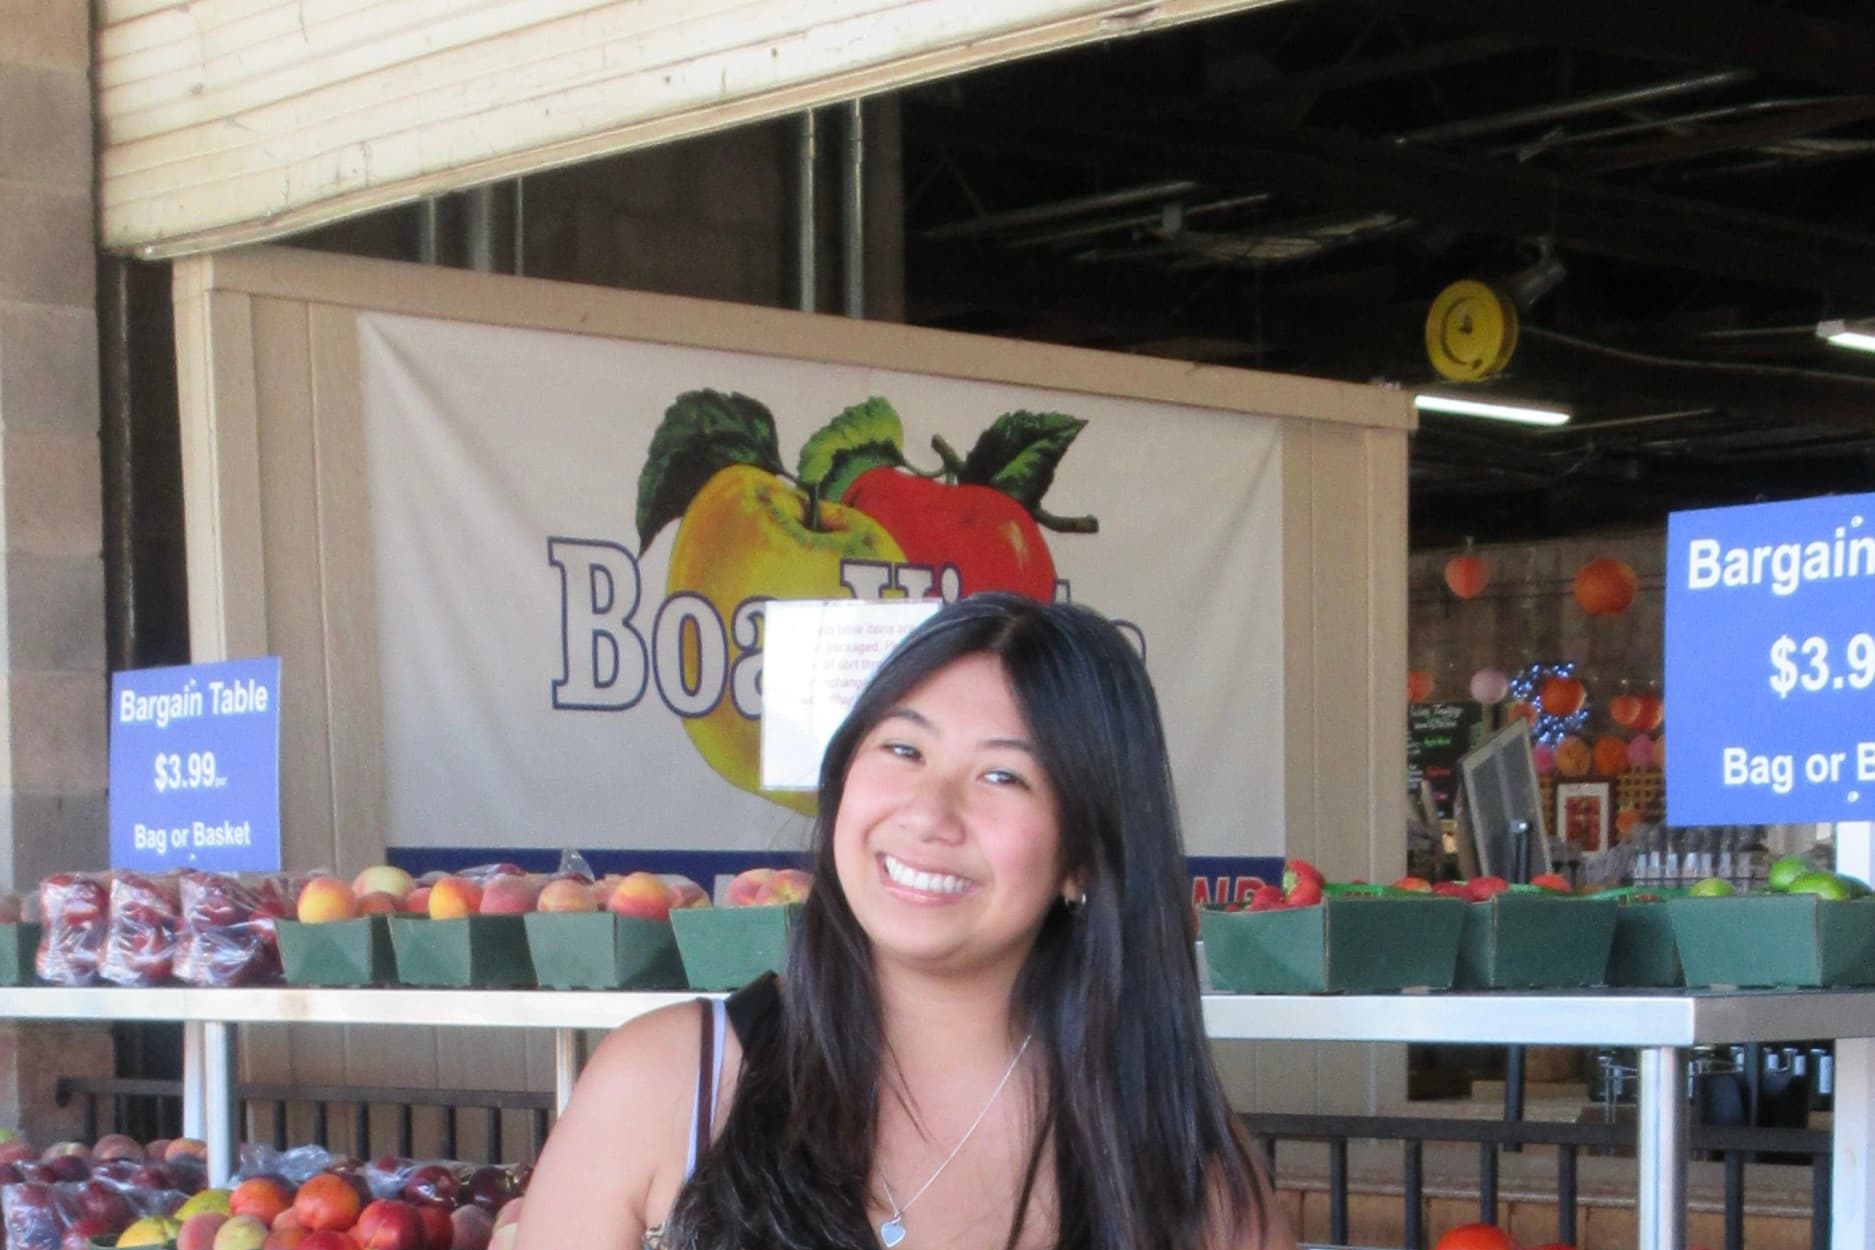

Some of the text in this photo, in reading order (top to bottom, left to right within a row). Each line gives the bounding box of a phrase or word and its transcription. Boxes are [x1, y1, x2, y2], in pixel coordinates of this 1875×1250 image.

[1688, 525, 1875, 597] Bargain
[120, 678, 269, 728] Bargain Table
[154, 751, 216, 793] $3.99
[1723, 747, 1793, 794] Bag
[1805, 752, 1846, 783] or
[134, 820, 252, 854] Bag or Basket
